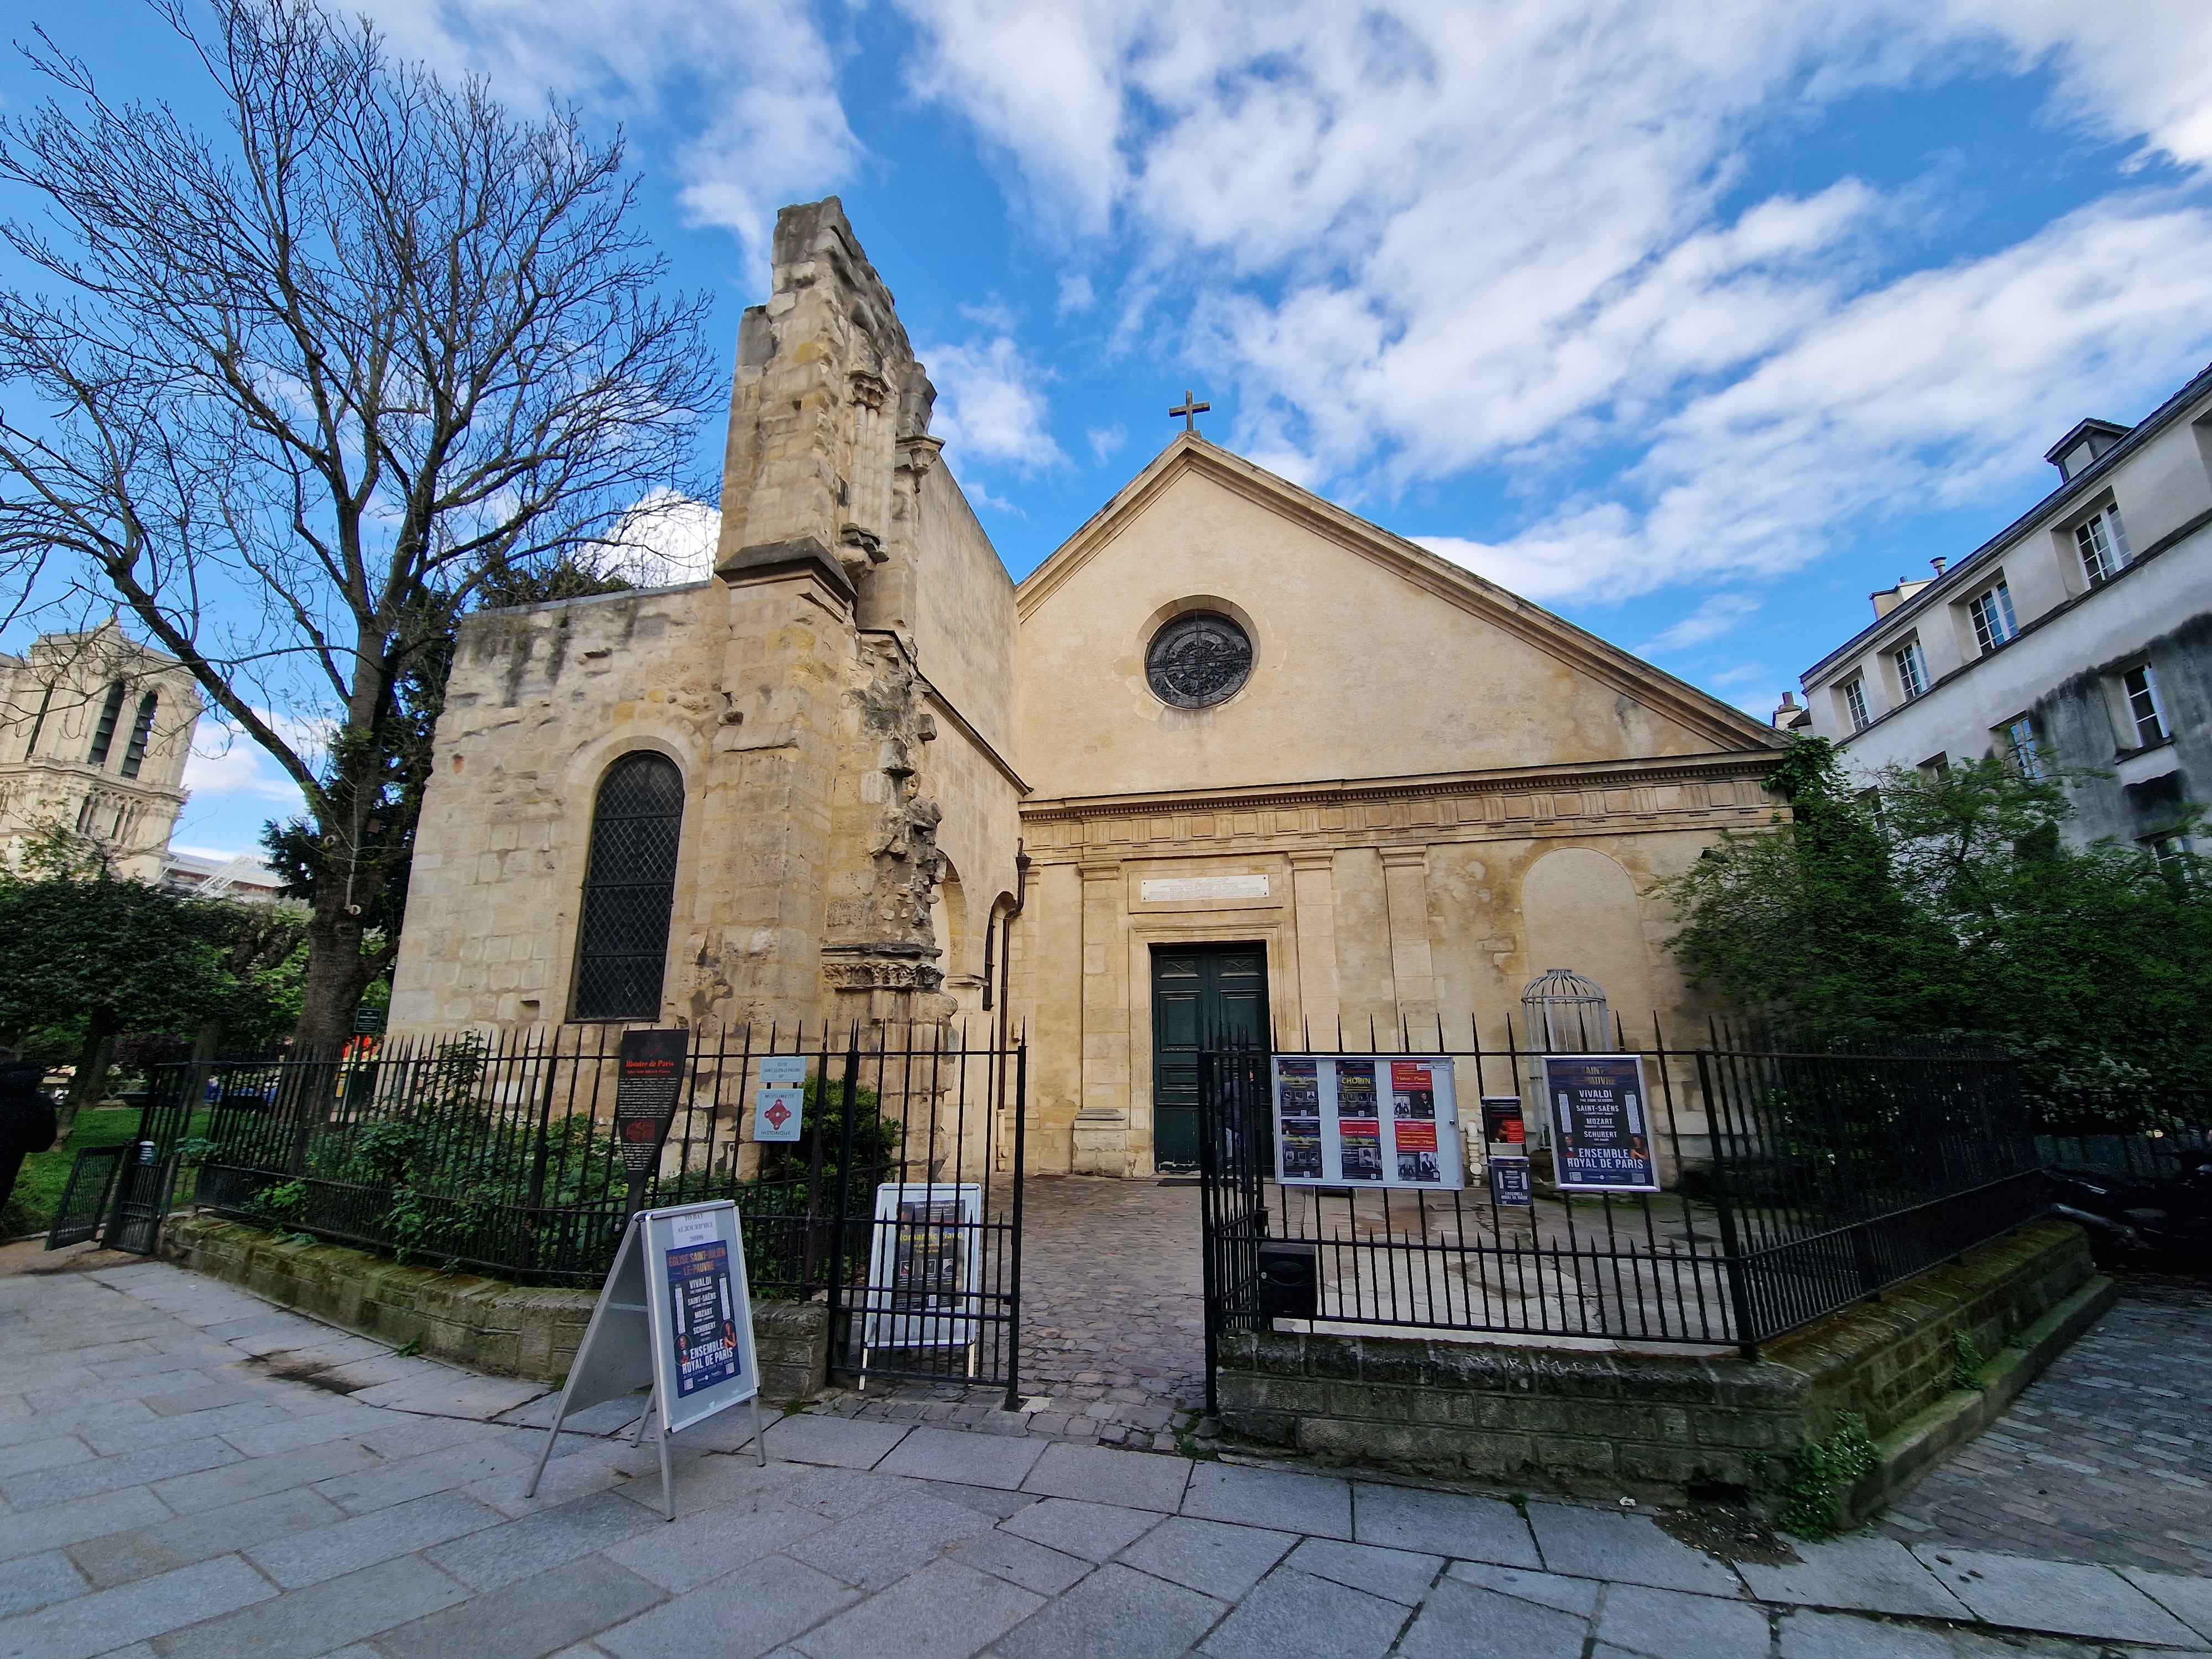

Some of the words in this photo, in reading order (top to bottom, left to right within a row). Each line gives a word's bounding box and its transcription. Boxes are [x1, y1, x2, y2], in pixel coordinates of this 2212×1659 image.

[1578, 1089, 1613, 1098] VIVALDI
[1575, 1104, 1620, 1112] SAINT-SAËNS
[1583, 1130, 1618, 1139] SCHUBERT
[1578, 1147, 1630, 1159] ENSEMBLE
[1567, 1157, 1598, 1168] ROYAL
[1600, 1159, 1613, 1168] DE
[1615, 1159, 1644, 1169] PARIS
[677, 1222, 713, 1233] AUJOURD'HUI
[899, 1232, 937, 1241] Romanic
[941, 1231, 963, 1239] iao
[668, 1254, 689, 1267] ÉGLISE
[688, 1275, 712, 1290] VIVALDI
[687, 1291, 717, 1306] SAINT-SAËNS
[694, 1307, 713, 1319] MOZART
[692, 1321, 717, 1335] SCHUBERT
[690, 1338, 724, 1360] ENSEMBLE
[681, 1358, 704, 1375] ROYAL
[705, 1353, 714, 1366] DE
[714, 1347, 733, 1363] PARIS
